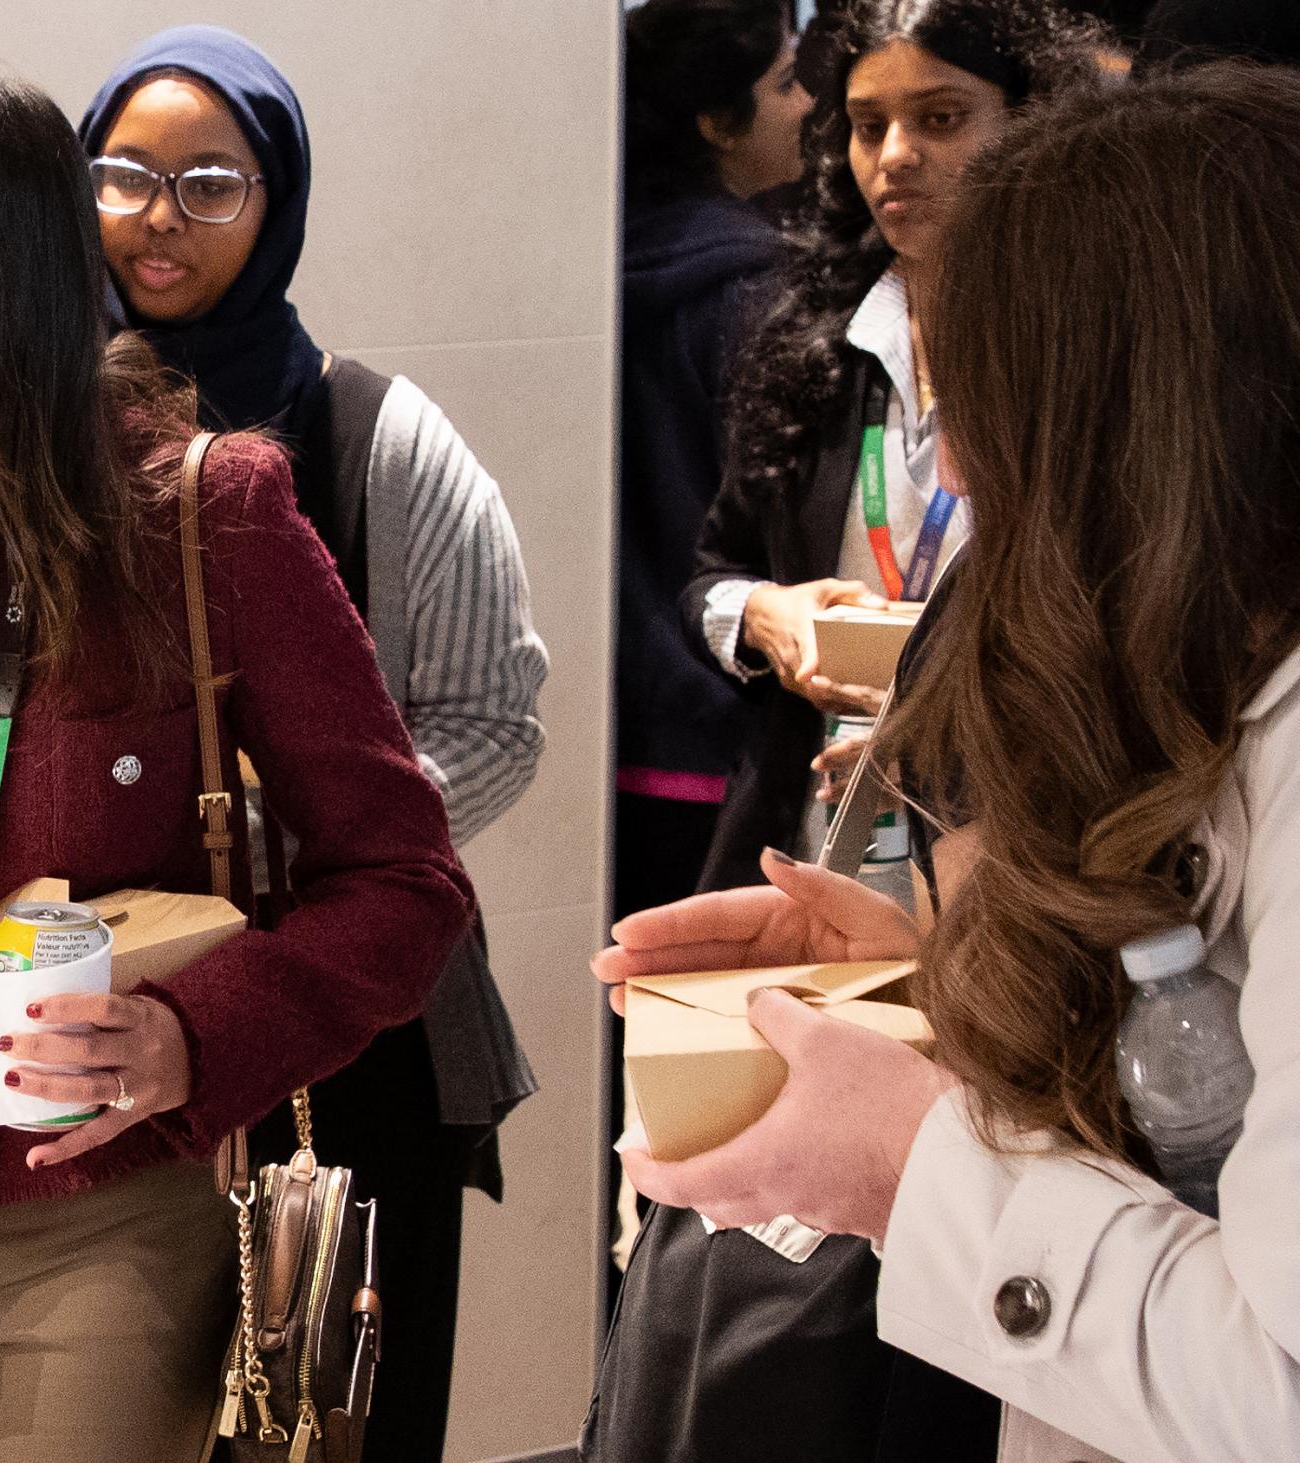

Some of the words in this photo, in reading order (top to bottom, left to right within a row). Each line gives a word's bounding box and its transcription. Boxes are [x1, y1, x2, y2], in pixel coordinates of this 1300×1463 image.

[37, 933, 68, 942] Nutrition
[69, 933, 87, 941] Facts
[36, 942, 60, 950] Valeur
